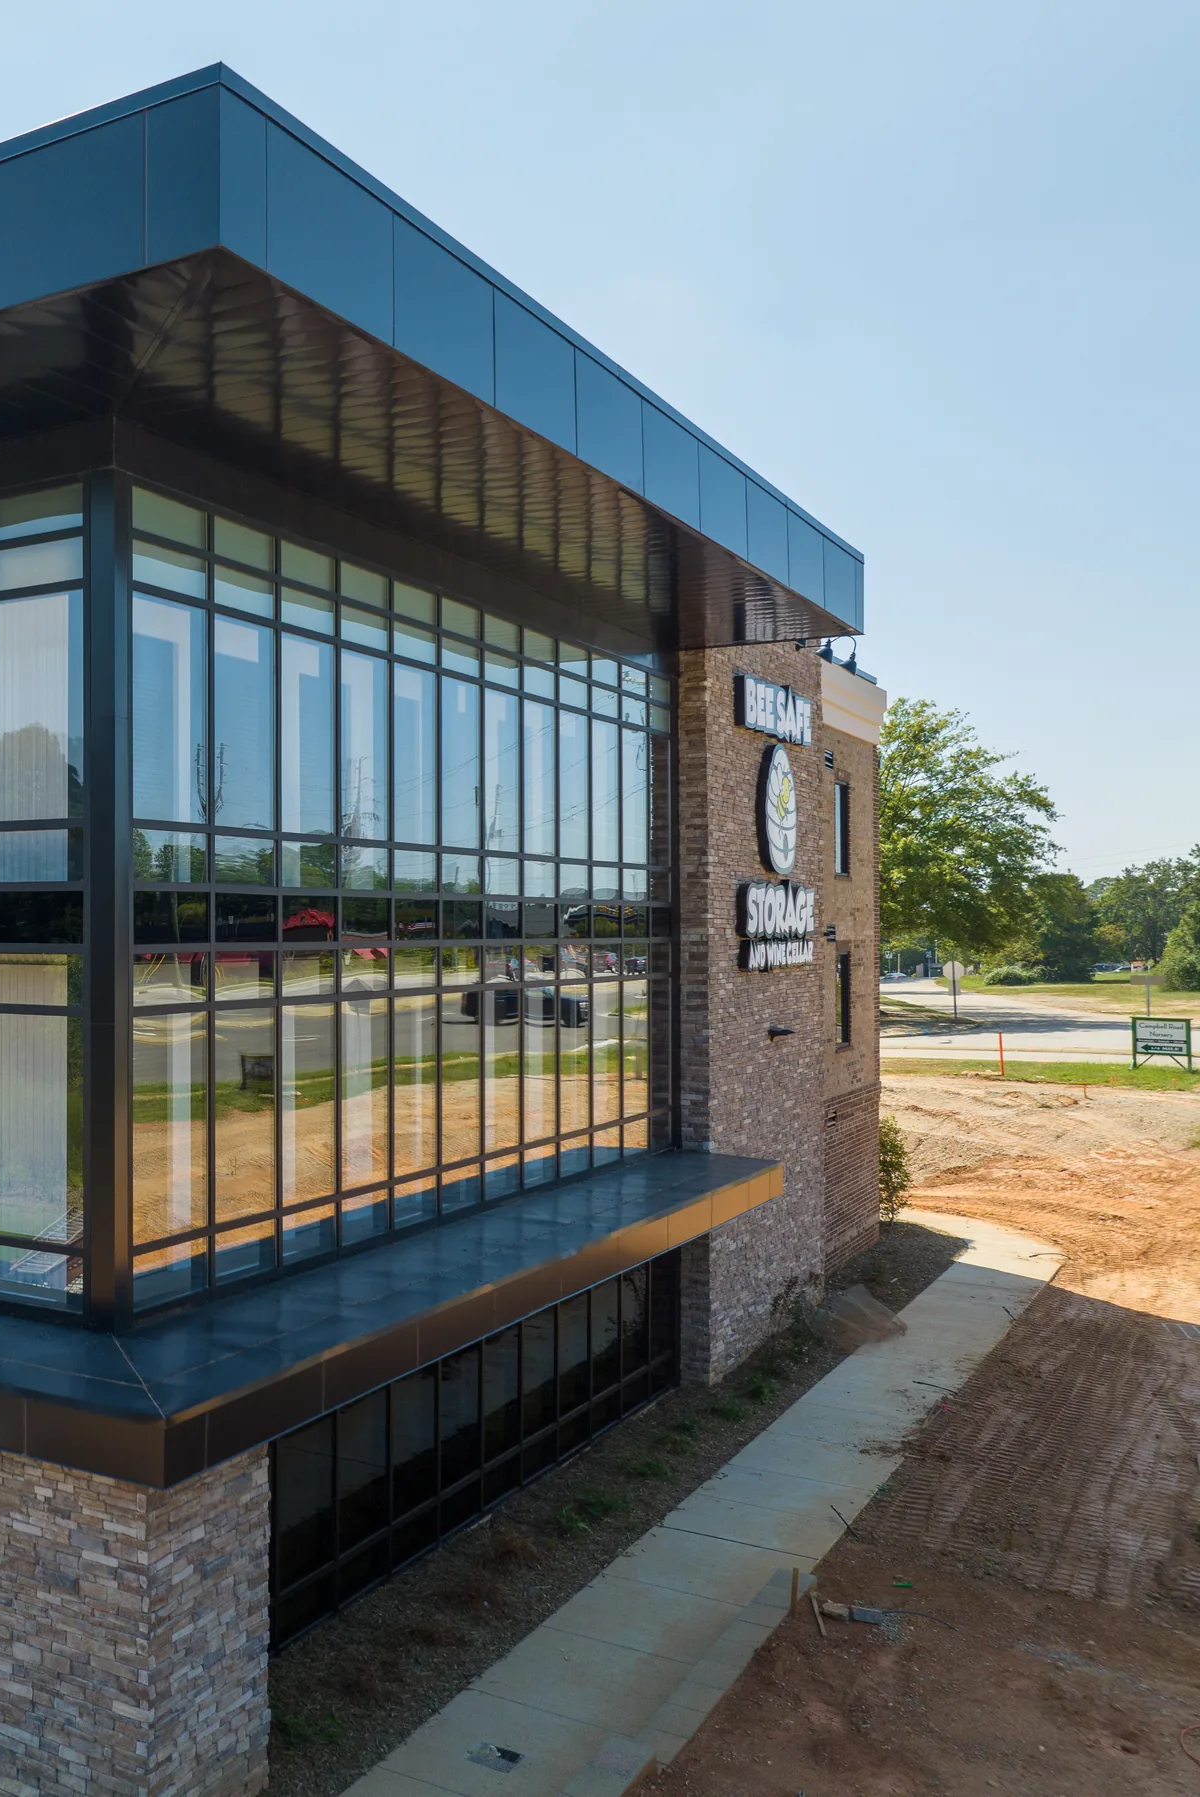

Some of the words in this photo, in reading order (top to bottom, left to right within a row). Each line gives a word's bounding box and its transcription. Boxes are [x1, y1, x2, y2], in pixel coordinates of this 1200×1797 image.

[746, 678, 774, 729] BEE
[776, 687, 812, 743] SAFE
[747, 886, 814, 935] STORAGE
[749, 943, 766, 967] AND
[767, 942, 786, 968] WINE
[786, 942, 813, 964] CELLAR
[1139, 1022, 1167, 1030] Campbell
